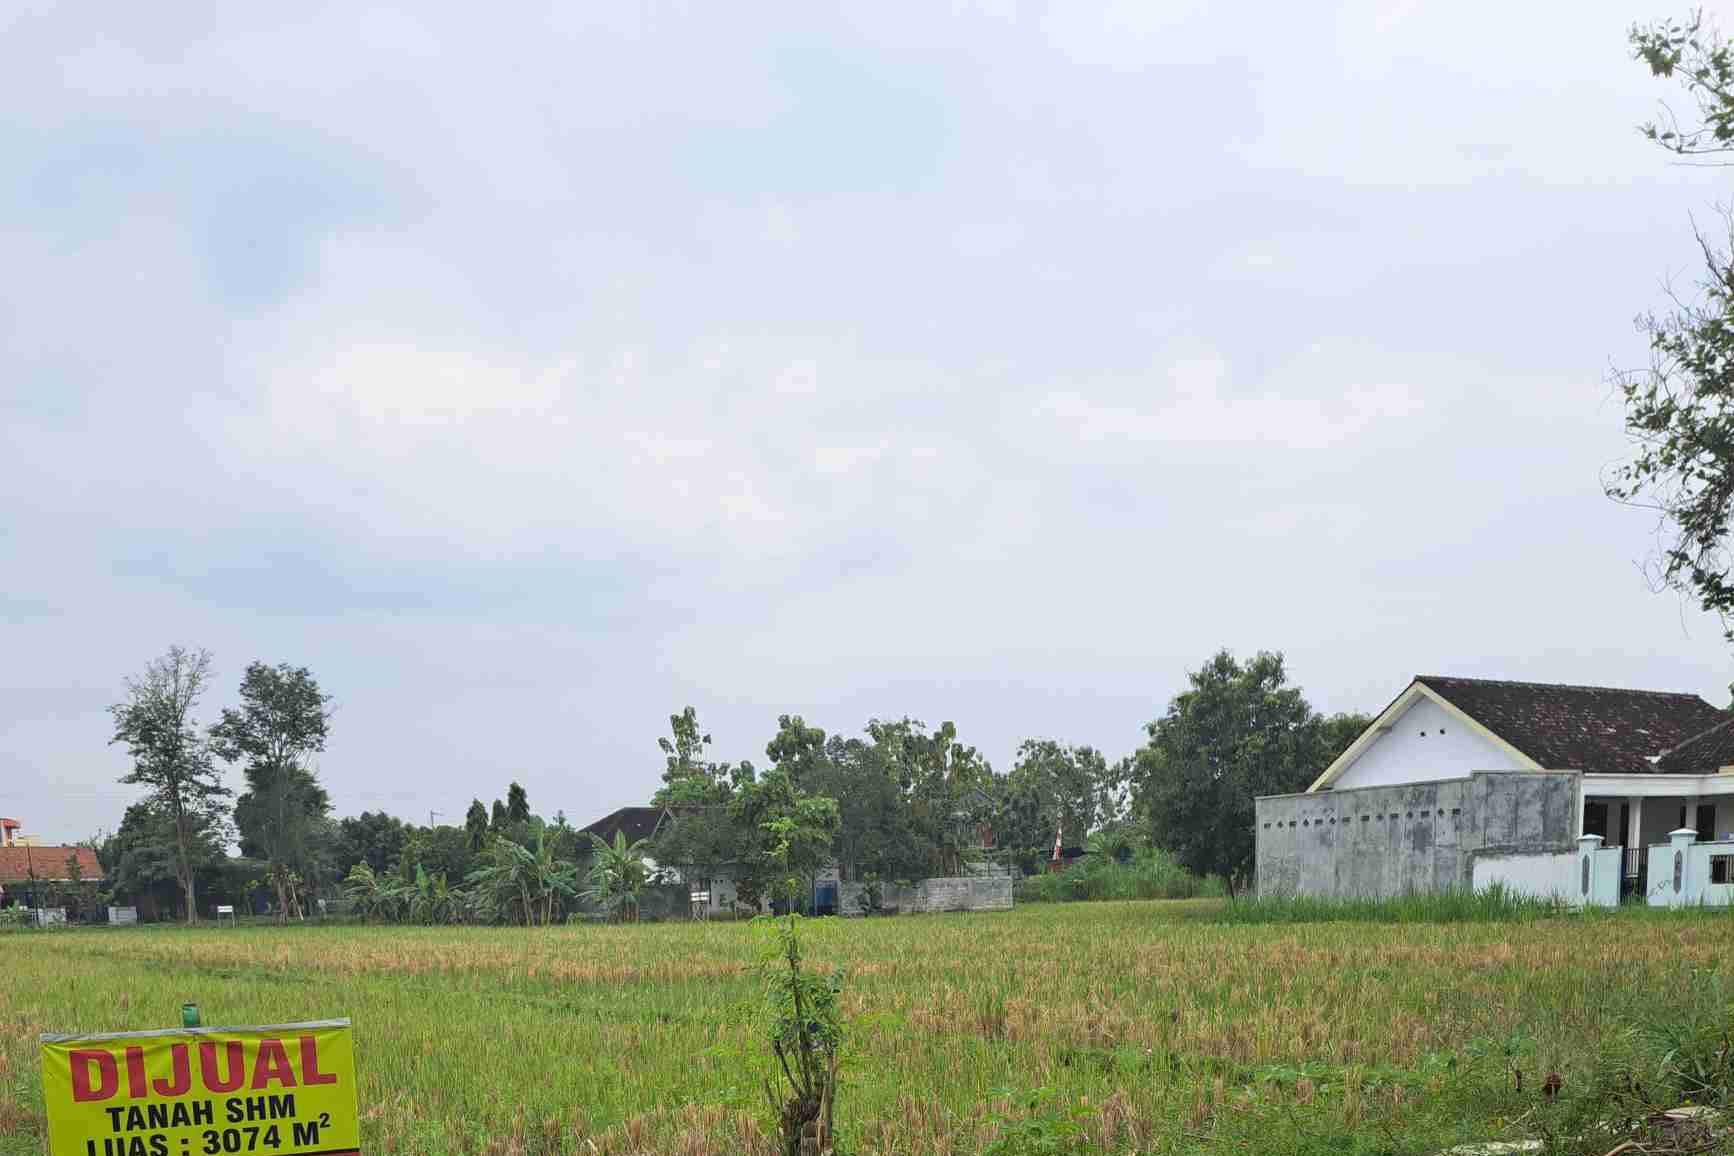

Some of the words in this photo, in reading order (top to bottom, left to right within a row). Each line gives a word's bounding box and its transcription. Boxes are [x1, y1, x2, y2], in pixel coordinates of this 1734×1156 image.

[69, 1035, 337, 1103] DIJUAL
[105, 1100, 214, 1133] TANAH
[226, 1094, 296, 1122] SHM
[180, 1138, 190, 1156] :
[202, 1125, 281, 1155] 3074
